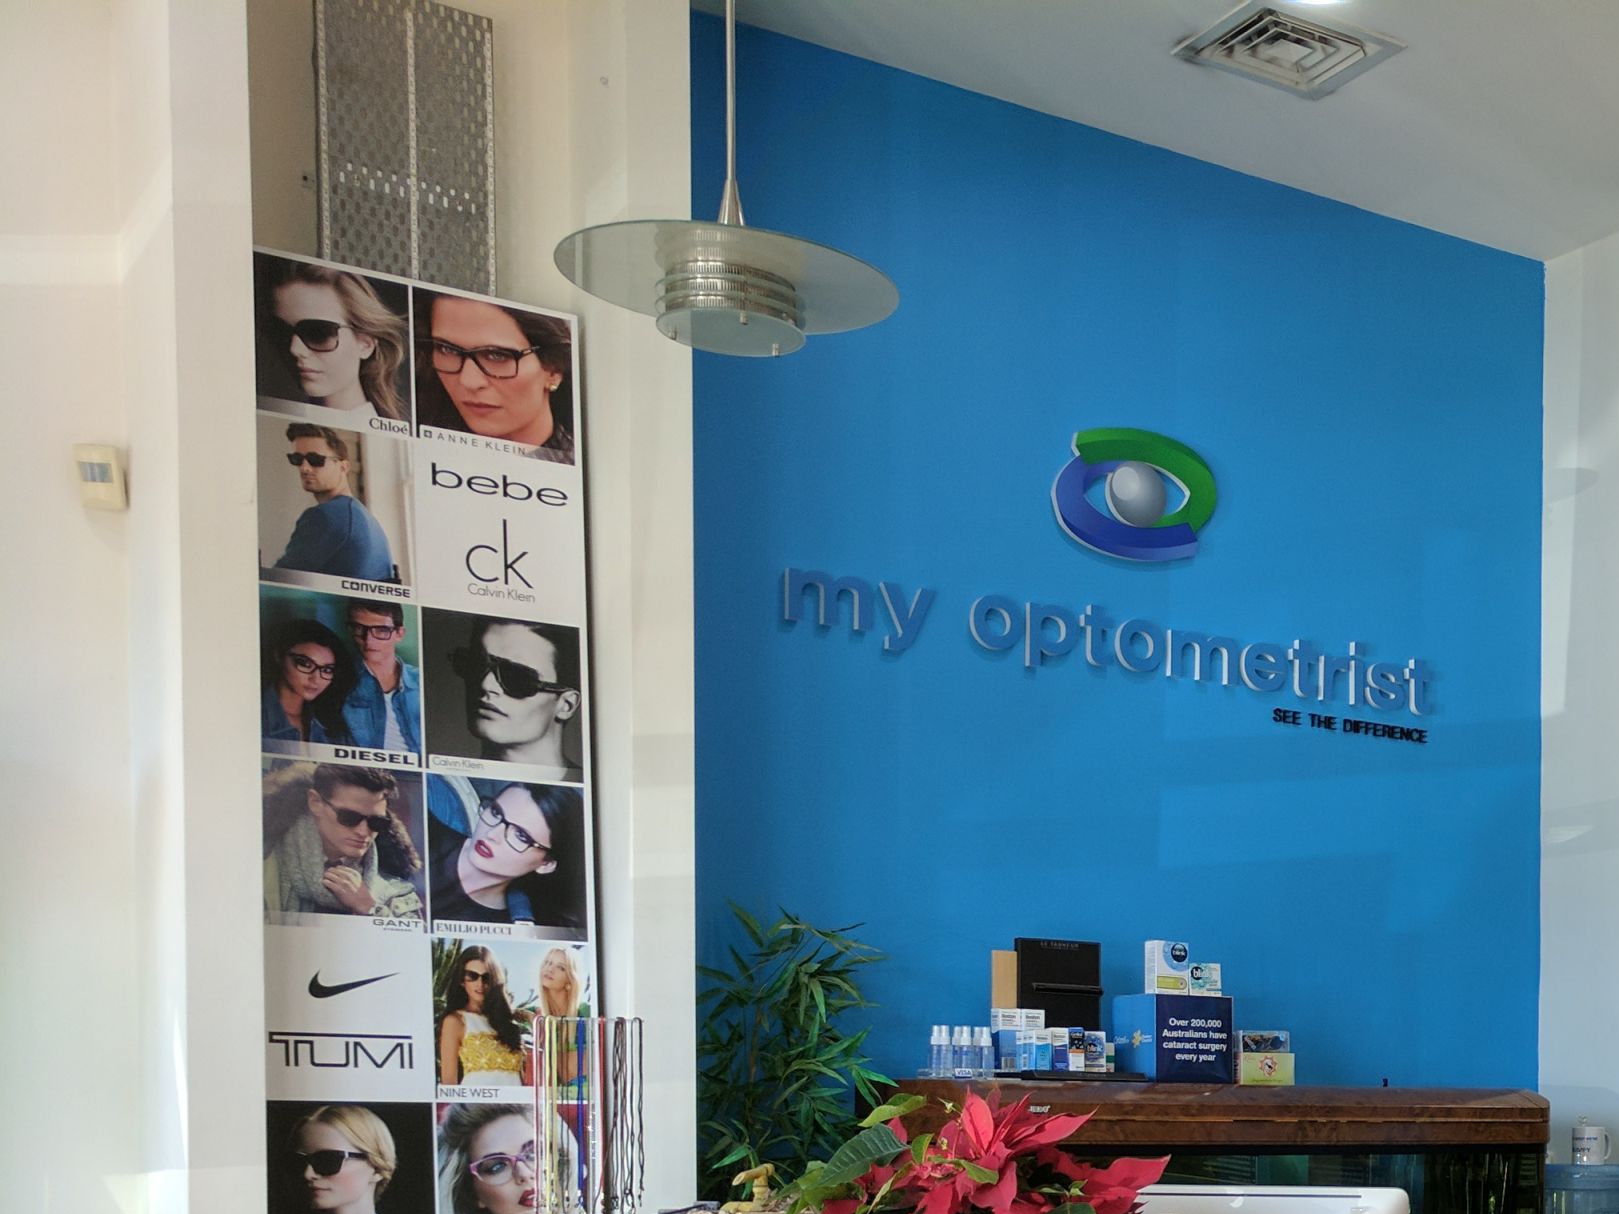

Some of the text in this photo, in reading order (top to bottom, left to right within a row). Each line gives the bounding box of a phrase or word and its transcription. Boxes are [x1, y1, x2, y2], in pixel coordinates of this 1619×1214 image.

[368, 417, 410, 435] Chloé
[437, 432, 526, 456] ANNE KLEIN
[431, 462, 569, 507] bebe
[465, 518, 534, 589] ck
[341, 579, 411, 598] CONVERSE
[467, 582, 536, 603] Calvin Klein
[782, 566, 1433, 717] my optometrist
[1271, 707, 1429, 744] SEE THE DIFFERENCE
[333, 747, 415, 766] DIESEL
[432, 757, 484, 770] Calvin Klein
[373, 918, 421, 928] GANT
[436, 922, 512, 935] EMILIO PUCCI
[1169, 1018, 1222, 1028] Over 200,000
[1162, 1029, 1228, 1039] Australians have
[268, 1031, 414, 1069] TUMI
[1163, 1041, 1227, 1052] cataract surgery
[1175, 1054, 1216, 1062] every year
[439, 1087, 500, 1099] NINE WEST
